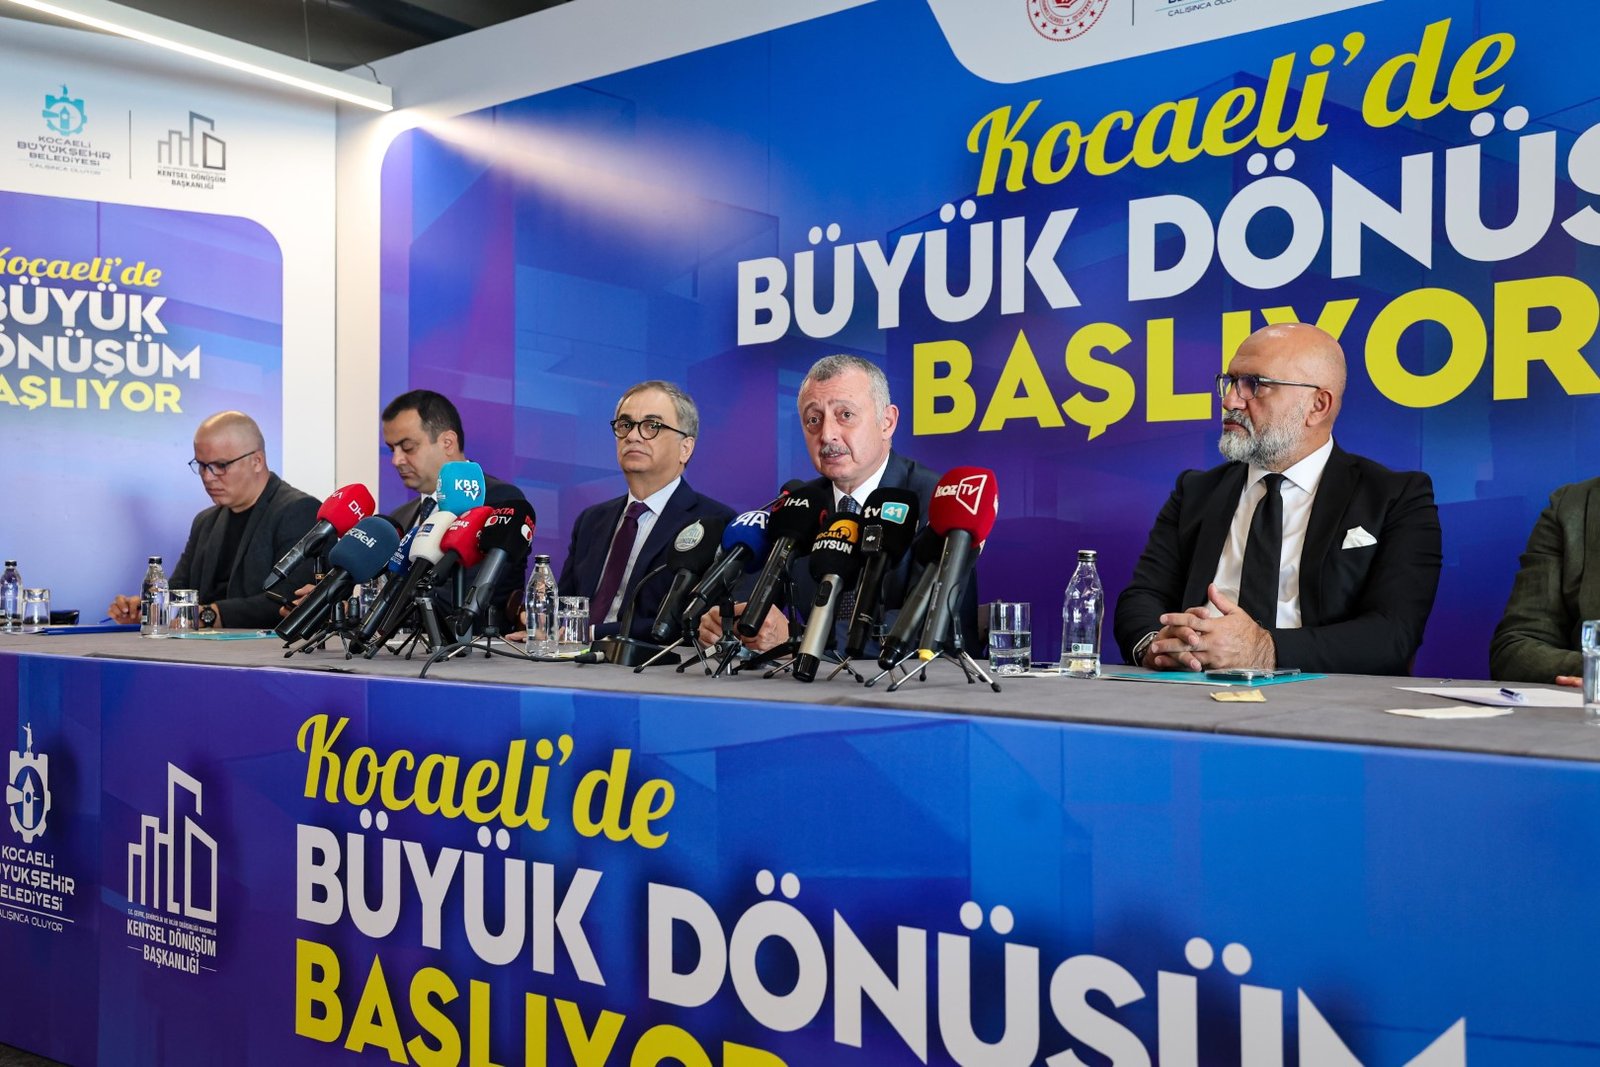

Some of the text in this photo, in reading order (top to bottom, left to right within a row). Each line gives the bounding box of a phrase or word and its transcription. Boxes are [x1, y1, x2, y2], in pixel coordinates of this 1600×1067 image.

[737, 200, 1080, 346] BÜYÜK
[0, 276, 168, 334] ÜYÜK
[0, 323, 200, 379] NÜŞÜM
[0, 374, 183, 413] AŞLIYOR
[455, 479, 480, 491] KBB
[464, 490, 479, 501] TV
[961, 483, 981, 496] TV
[347, 499, 366, 521] DH
[498, 516, 512, 525] TV
[731, 512, 765, 530] AA
[864, 505, 903, 519] tv 41
[2, 845, 54, 869] KOCAELİ
[0, 863, 75, 896] YÜKŞEHİR
[0, 883, 63, 912] ELEDİYESİ
[296, 808, 606, 987] BÜYÜK
[0, 908, 63, 933] LIŞINCA OLUYOR
[127, 918, 167, 944] KENTSEL
[168, 928, 217, 958] DÖNÜŞÜM
[143, 943, 200, 975] BAŞKANLIĞI
[295, 938, 788, 1067] BAŞLIY
